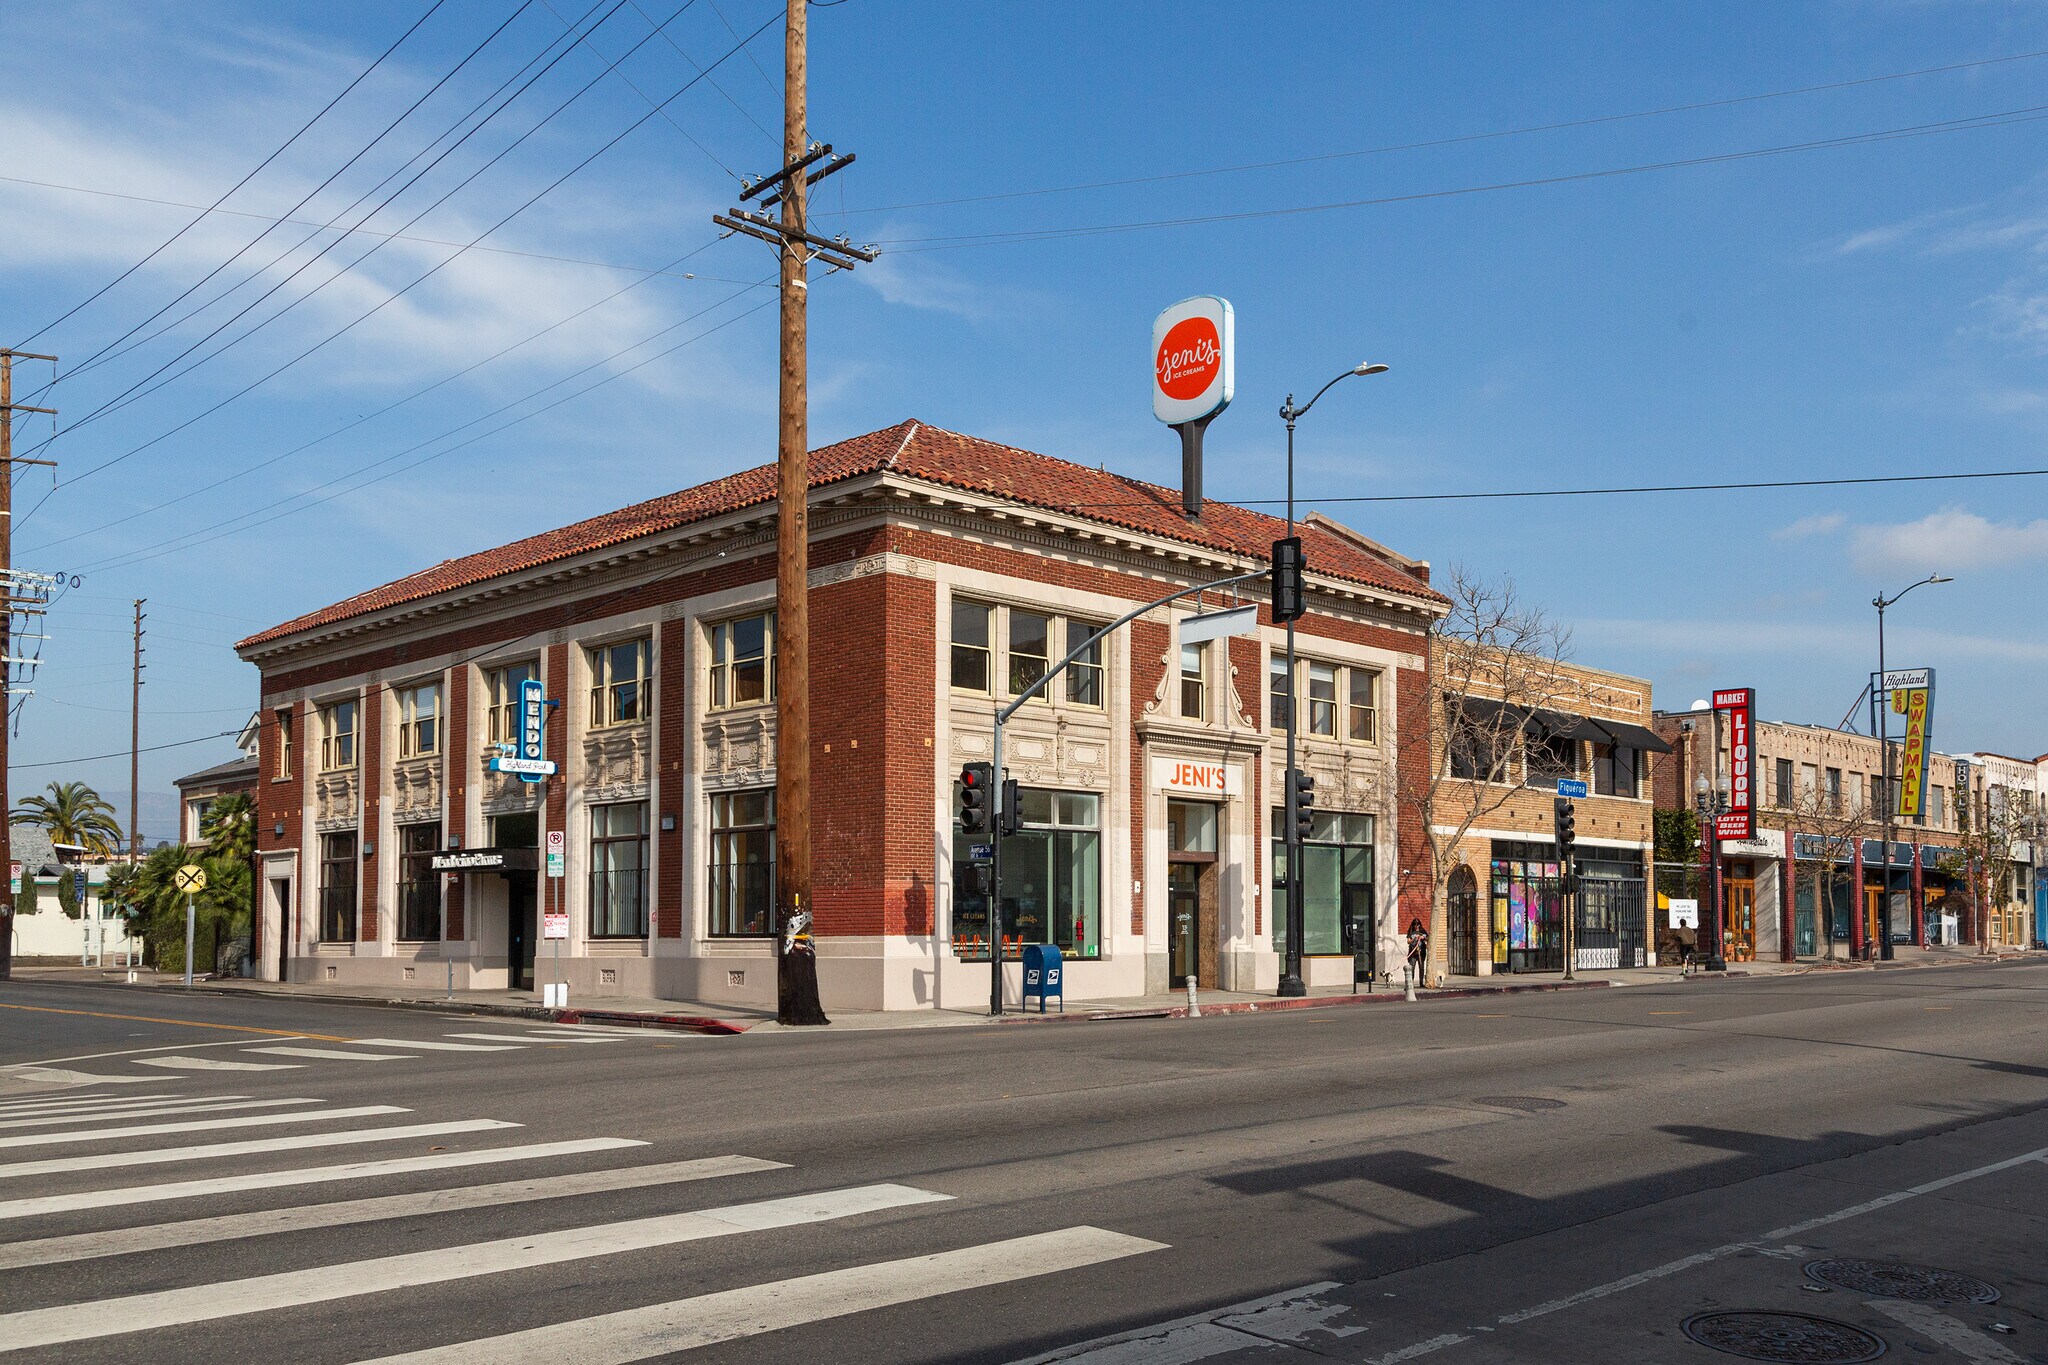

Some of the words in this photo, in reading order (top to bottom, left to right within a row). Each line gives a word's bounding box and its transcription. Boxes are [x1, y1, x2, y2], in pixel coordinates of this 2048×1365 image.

[1156, 339, 1220, 383] jeni's
[1183, 366, 1205, 377] CREAMS
[1884, 672, 1927, 689] Highland
[1716, 692, 1746, 705] MARKET
[525, 687, 541, 758] MENDO
[1735, 714, 1748, 807] LIQUOR
[1170, 763, 1226, 790] JENI'S
[1559, 782, 1586, 794] Figueroa
